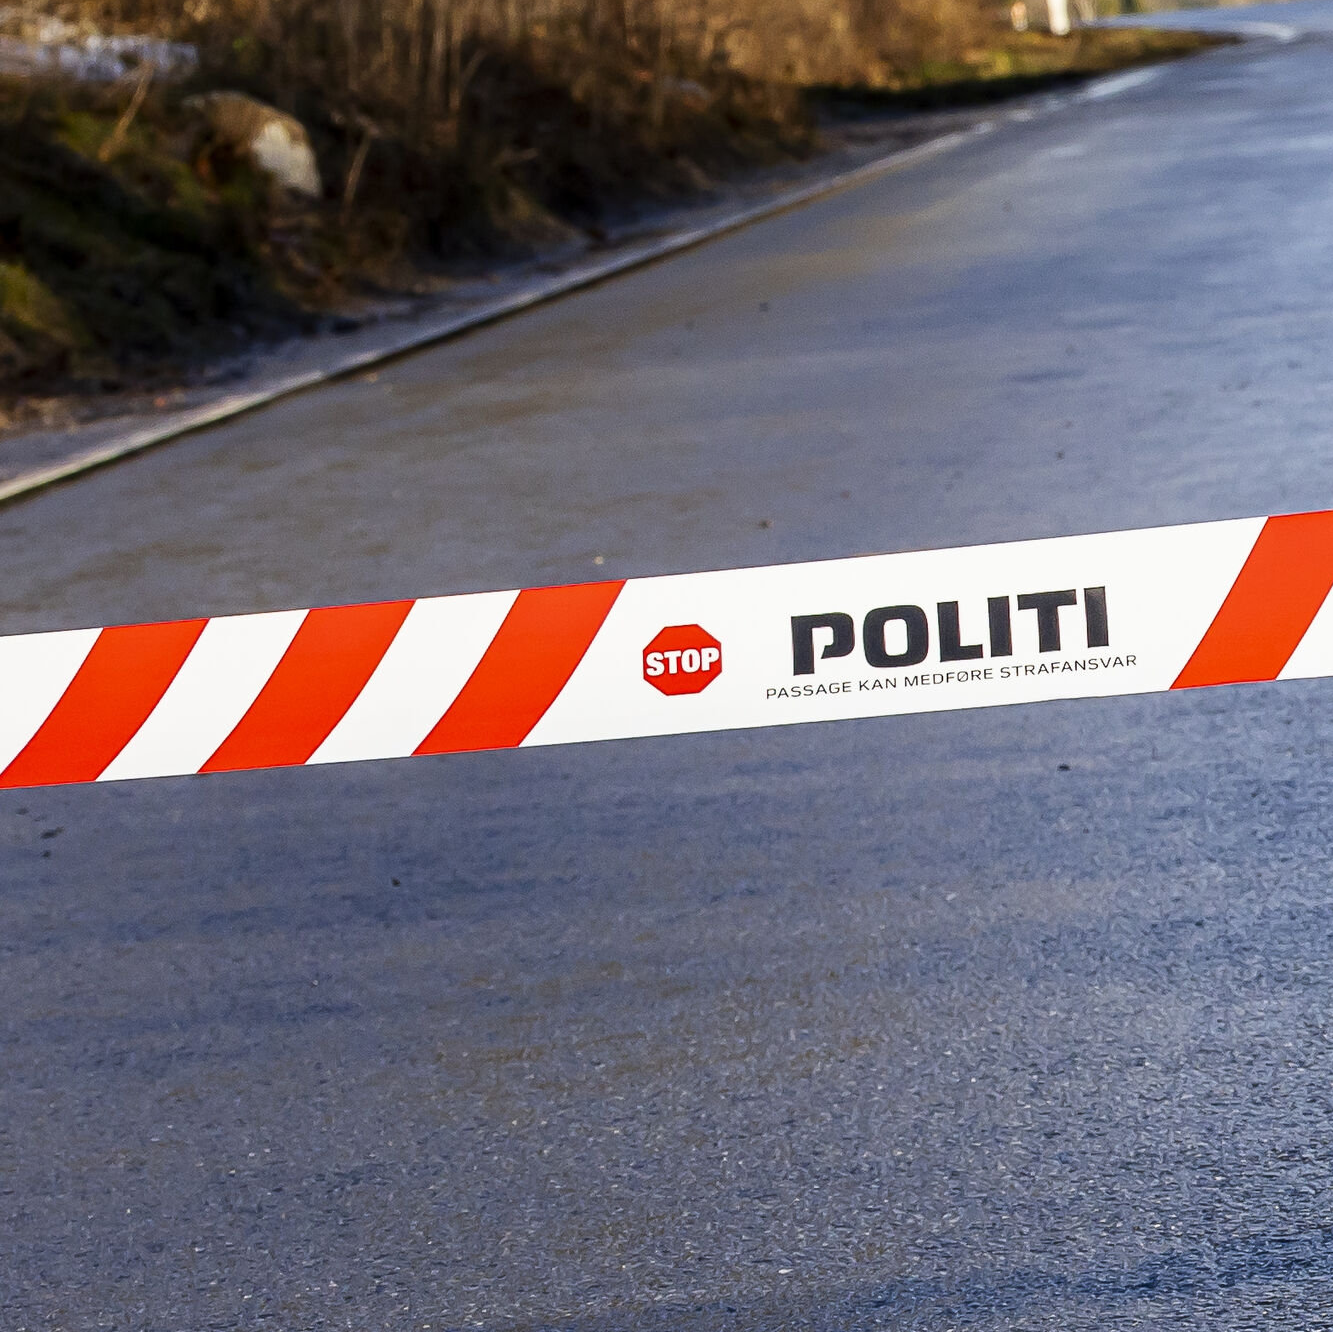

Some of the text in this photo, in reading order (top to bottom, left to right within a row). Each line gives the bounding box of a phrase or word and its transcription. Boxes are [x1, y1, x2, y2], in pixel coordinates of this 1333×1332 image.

[791, 586, 1110, 677] POLITI
[647, 648, 720, 676] STOP
[766, 655, 1137, 700] PASSAGE KAN MEDFØRE STRAFANSVAR
